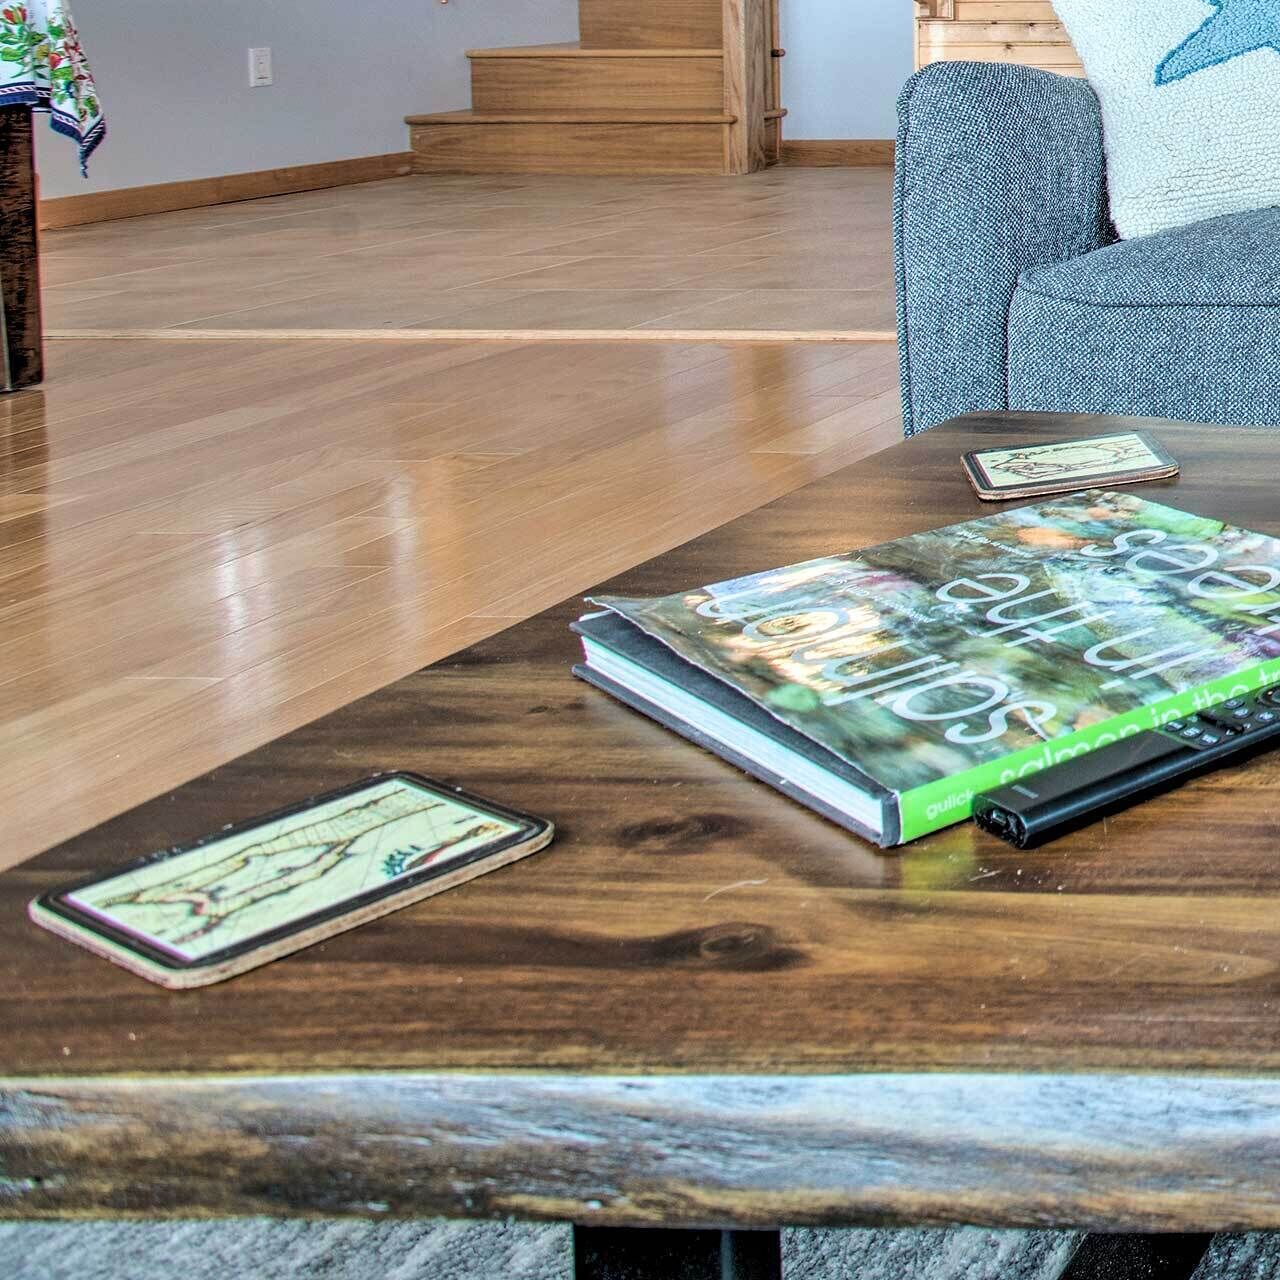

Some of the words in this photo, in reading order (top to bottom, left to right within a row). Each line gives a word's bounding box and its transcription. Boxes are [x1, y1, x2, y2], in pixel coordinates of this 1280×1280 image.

[936, 570, 1132, 650] the
[1075, 602, 1216, 693] in
[695, 584, 1057, 746] salmon
[926, 788, 976, 820] gulick
